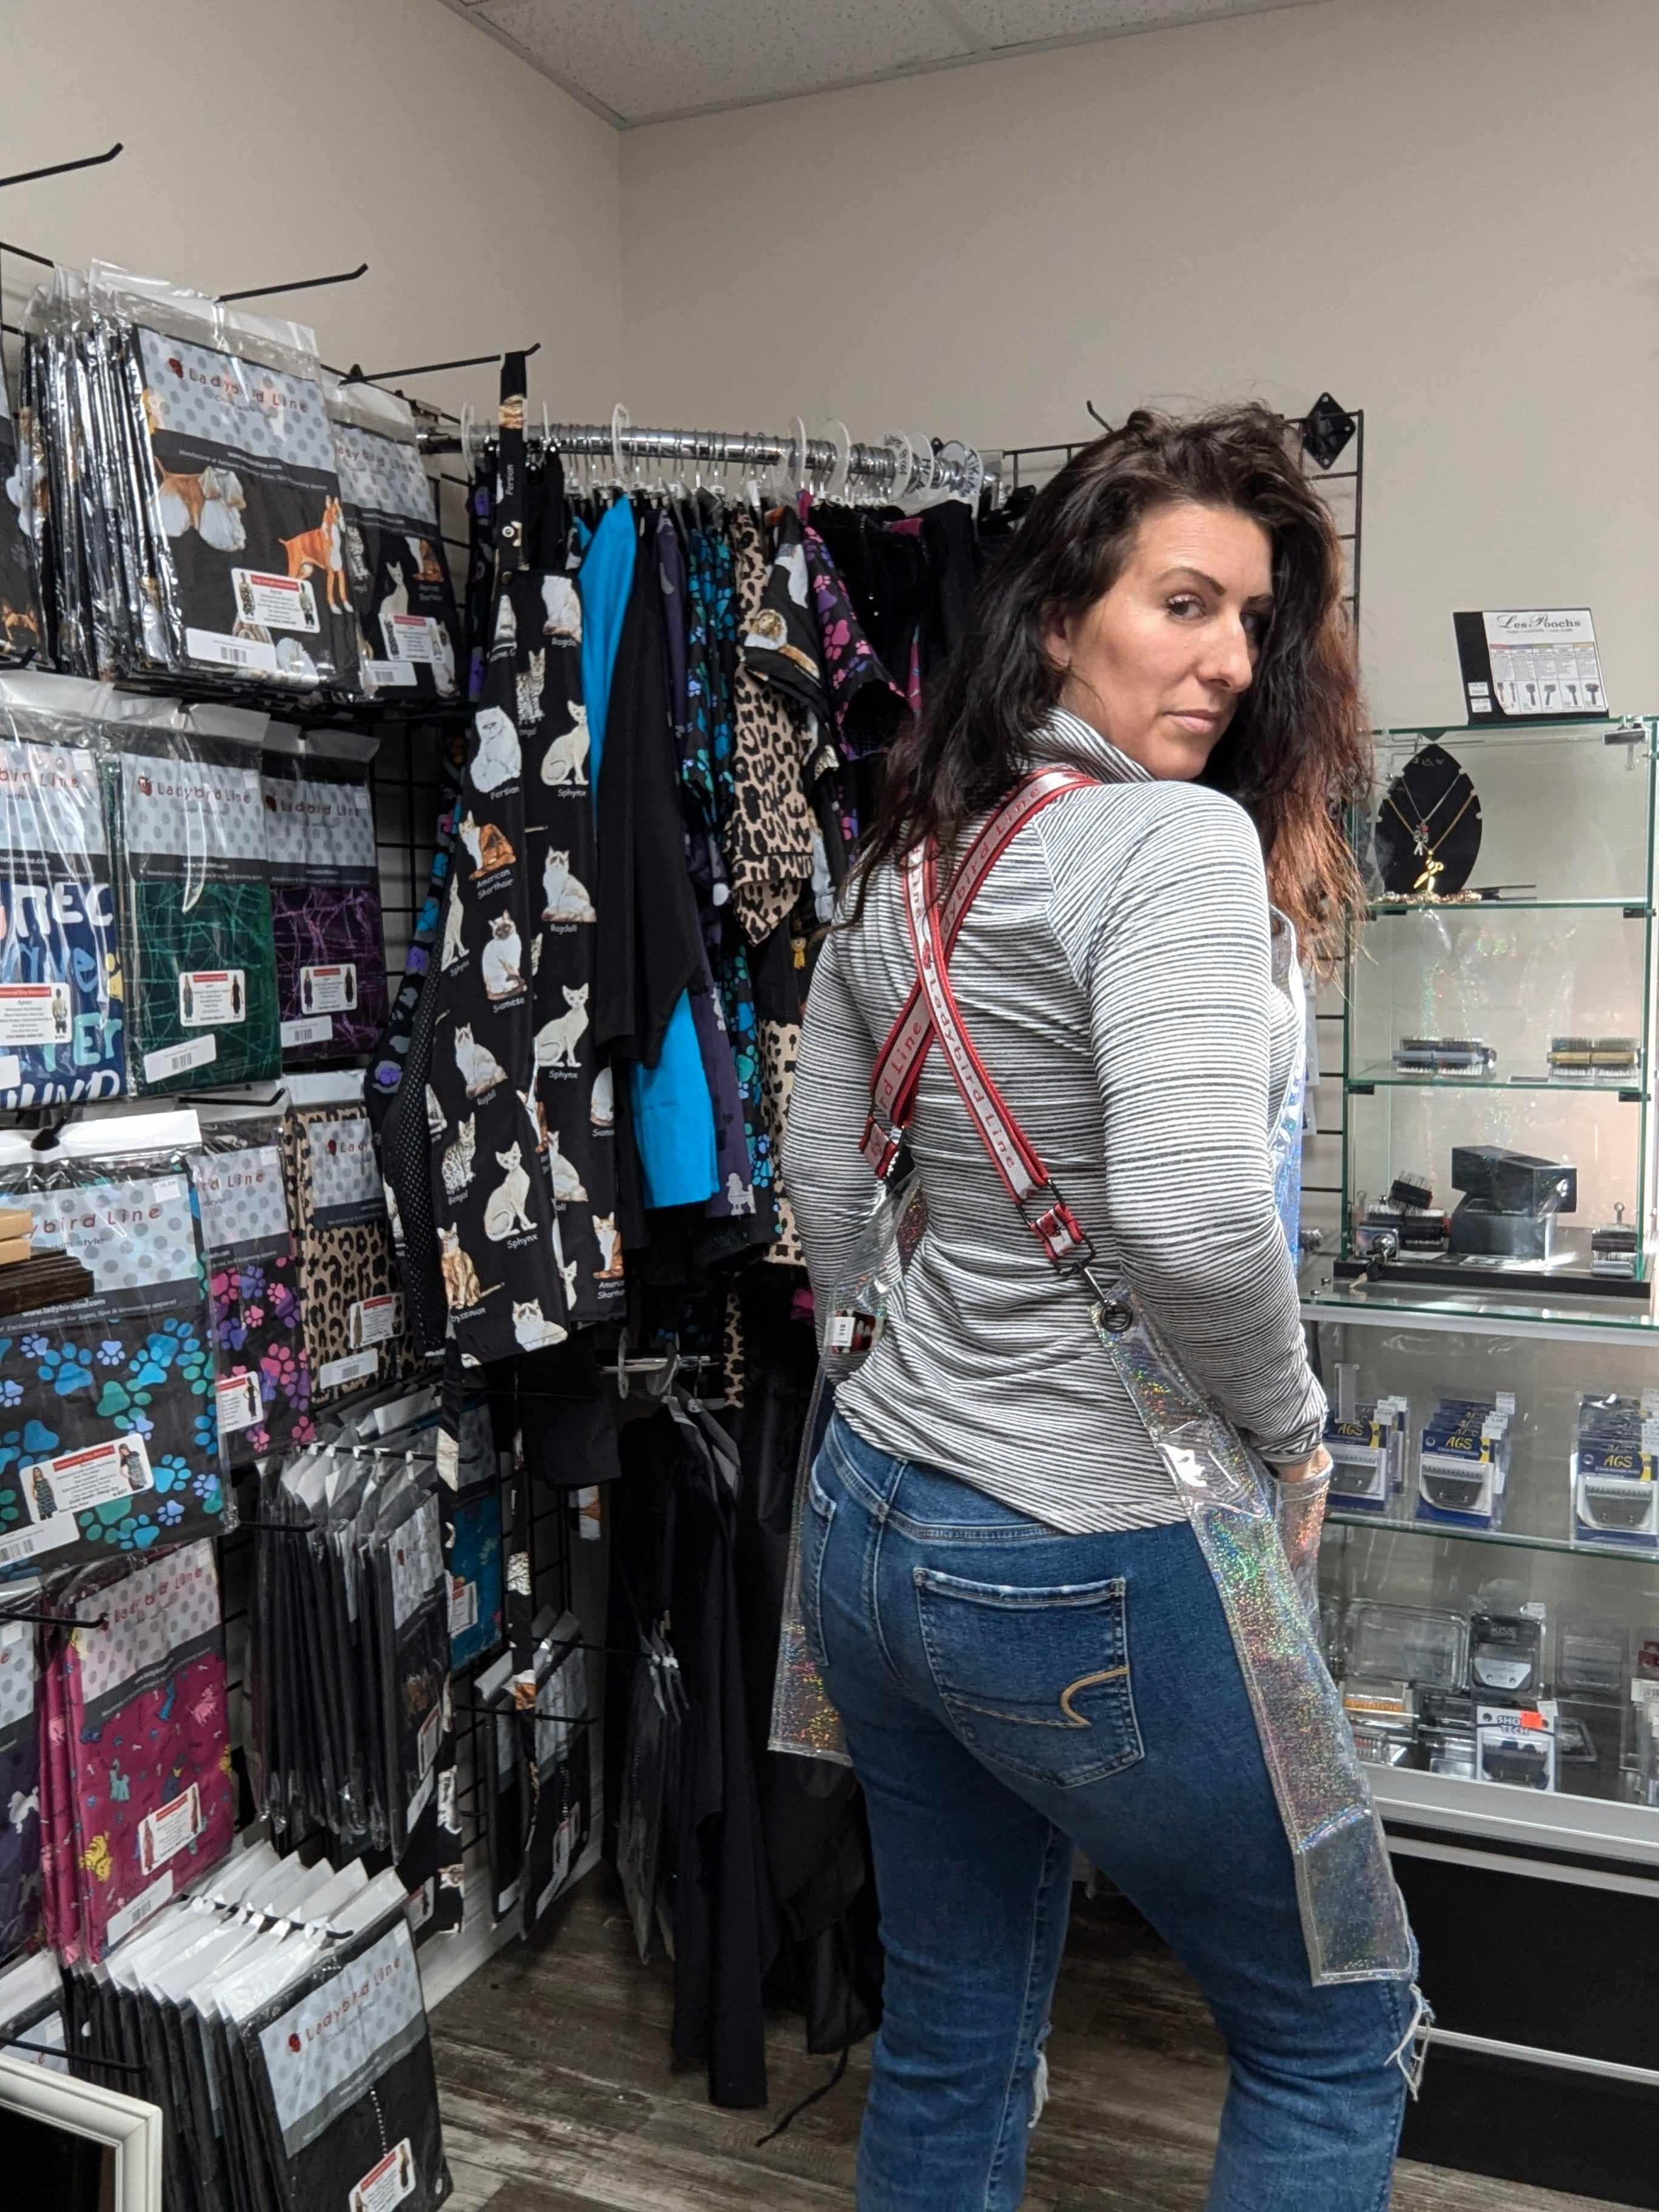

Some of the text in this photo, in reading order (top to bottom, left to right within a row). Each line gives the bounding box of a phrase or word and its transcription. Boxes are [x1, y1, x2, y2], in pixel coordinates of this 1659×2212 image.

[1496, 613, 1581, 629] Les Poochs
[225, 789, 252, 804] Line
[490, 786, 520, 800] Persian
[557, 788, 586, 799] Sphynx
[996, 788, 1041, 835] Line
[477, 868, 511, 889] American
[550, 923, 577, 934] Ragdoll
[493, 996, 526, 1013] Siamese
[891, 1022, 922, 1074] Line
[548, 1070, 578, 1079] Sphynx
[985, 1114, 1014, 1168] Line
[227, 1170, 265, 1187] Line
[107, 1207, 162, 1225] Line
[507, 1232, 539, 1249] Sphynx
[1337, 1423, 1364, 1436] AGS
[1446, 1436, 1473, 1450] AGS
[1604, 1455, 1634, 1468] AGS
[1490, 1626, 1515, 1635] KISS
[373, 1957, 400, 1986] Line
